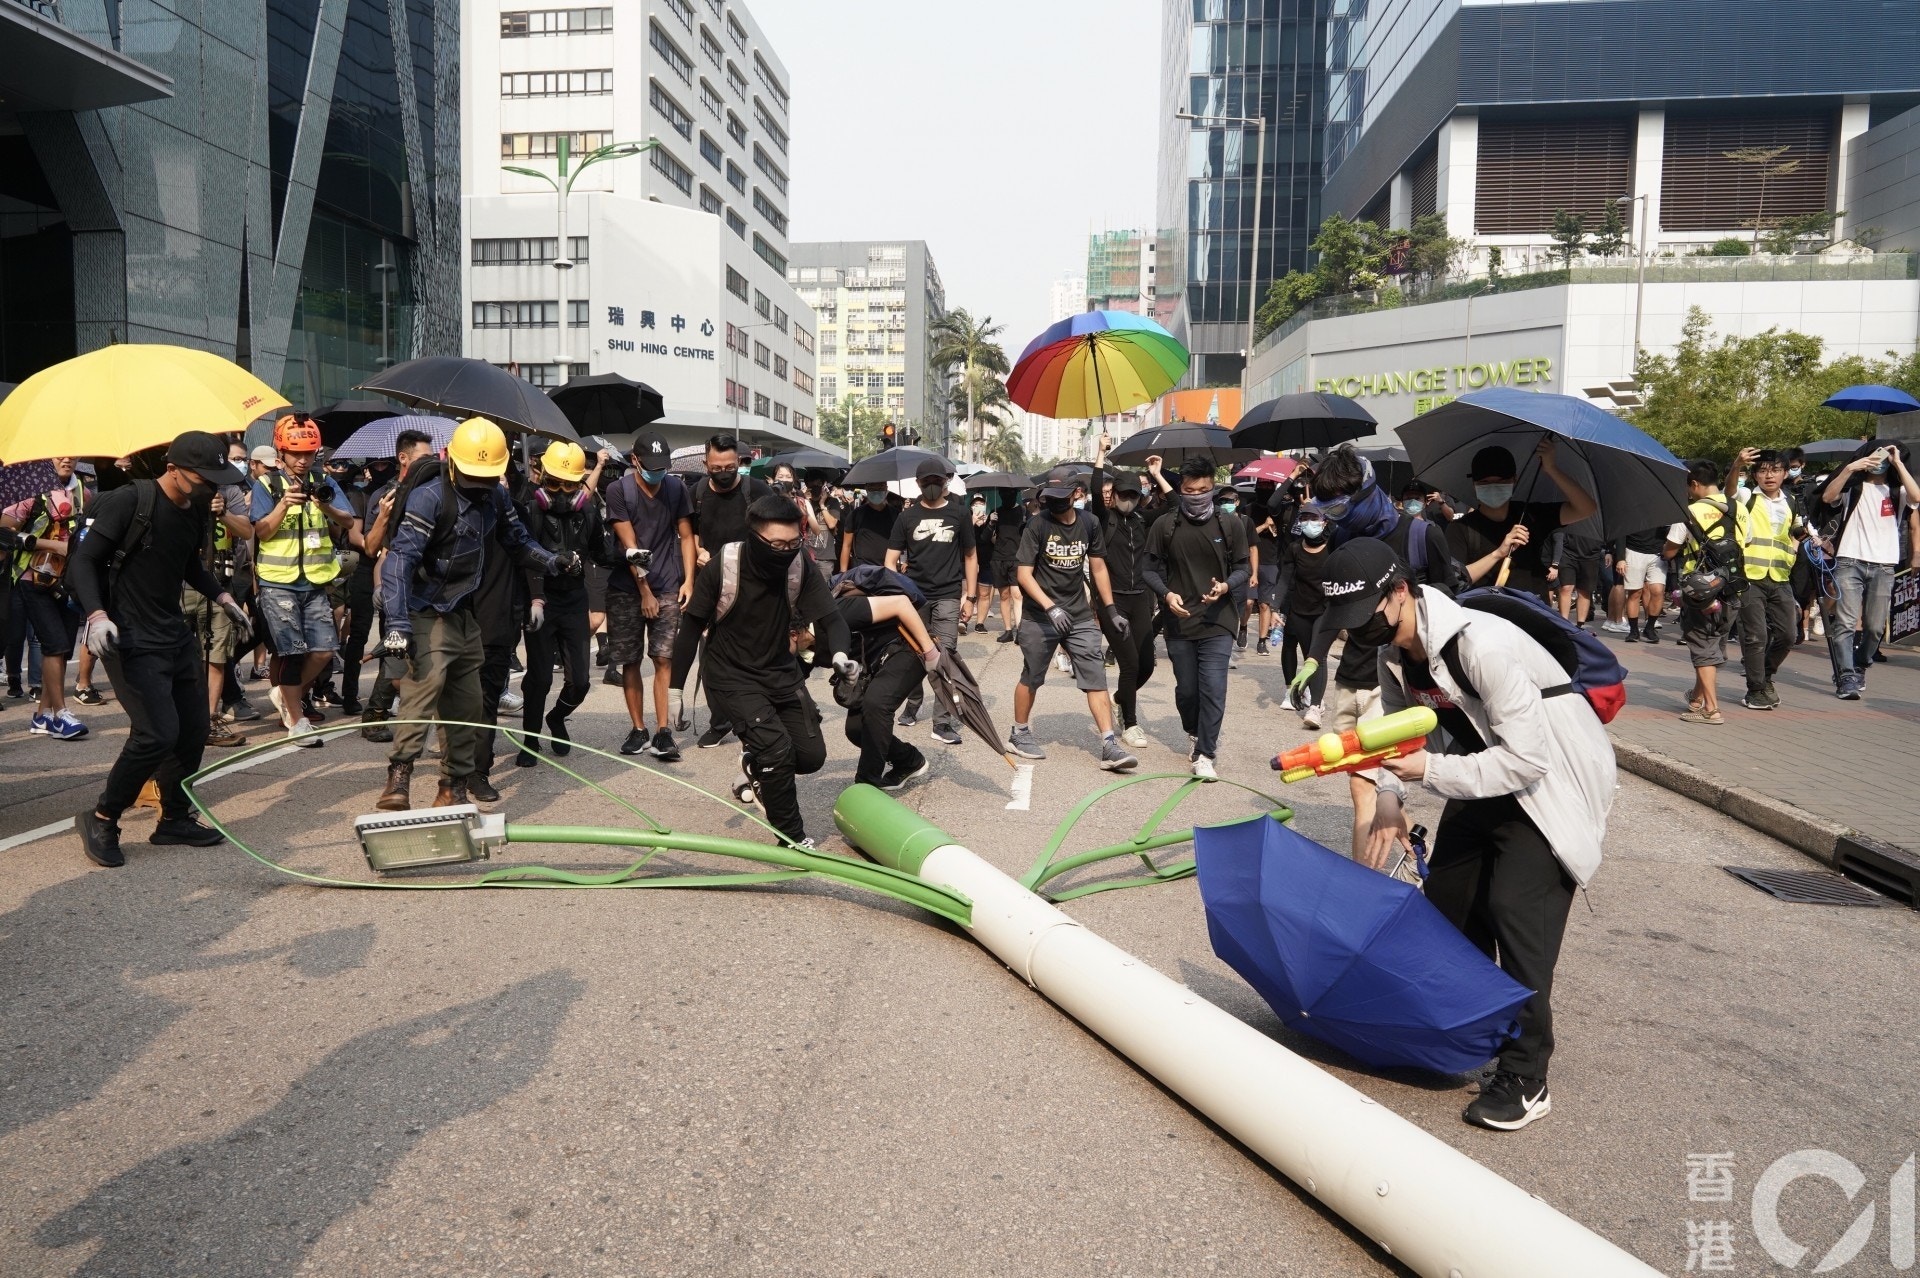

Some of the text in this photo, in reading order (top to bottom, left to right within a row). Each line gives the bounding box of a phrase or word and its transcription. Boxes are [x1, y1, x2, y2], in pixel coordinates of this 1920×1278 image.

[607, 305, 715, 338] 瑞興中心
[608, 338, 715, 360] SHUI HING CENTRE
[1315, 357, 1553, 399] EXCHANGE TOWER
[242, 395, 262, 408] DHL
[287, 431, 318, 441] PRESS
[1045, 540, 1089, 557] Barëly
[1322, 579, 1366, 597] Titleist
[1376, 572, 1390, 588] PRO
